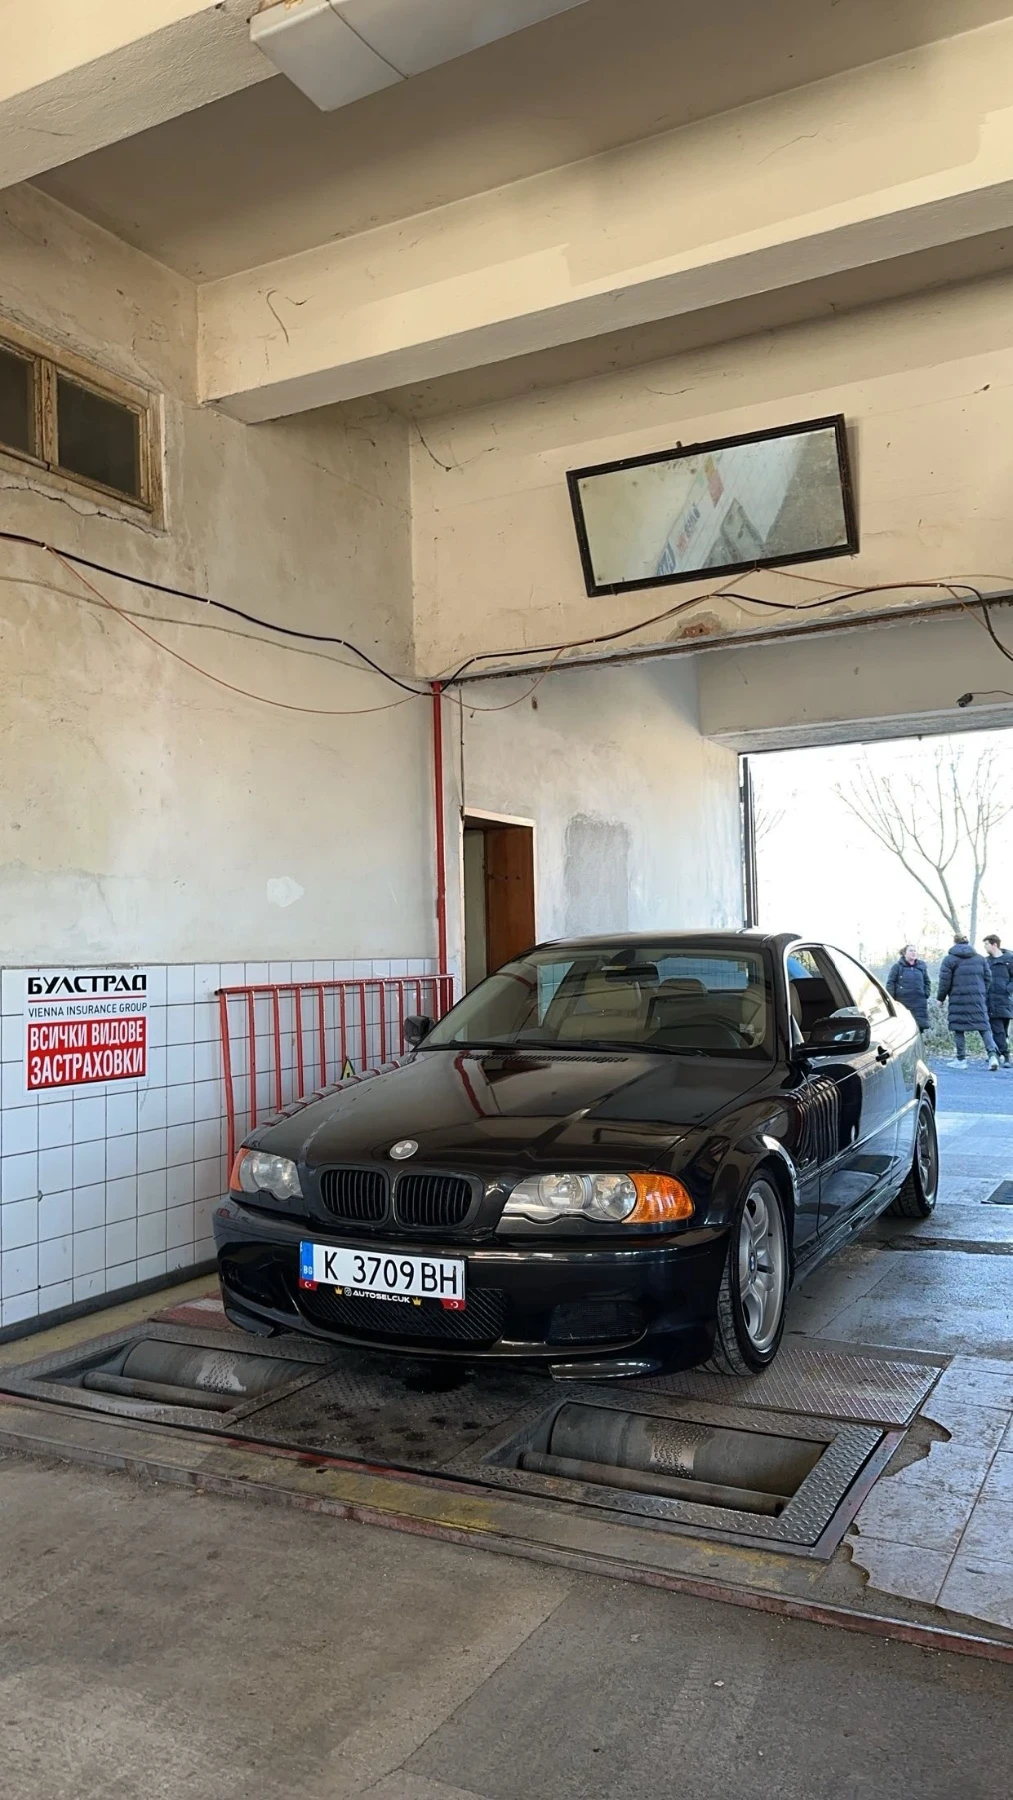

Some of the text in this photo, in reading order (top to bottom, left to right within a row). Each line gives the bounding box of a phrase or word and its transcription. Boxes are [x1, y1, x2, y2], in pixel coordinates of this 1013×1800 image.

[28, 974, 147, 994] БУЛСТРАД
[28, 1002, 148, 1018] VIENNA INSURANCE GROUP
[30, 1020, 144, 1051] ВСИЧКИ ВИДОВЕ
[30, 1047, 143, 1085] ЗАСТРАХОВКИ
